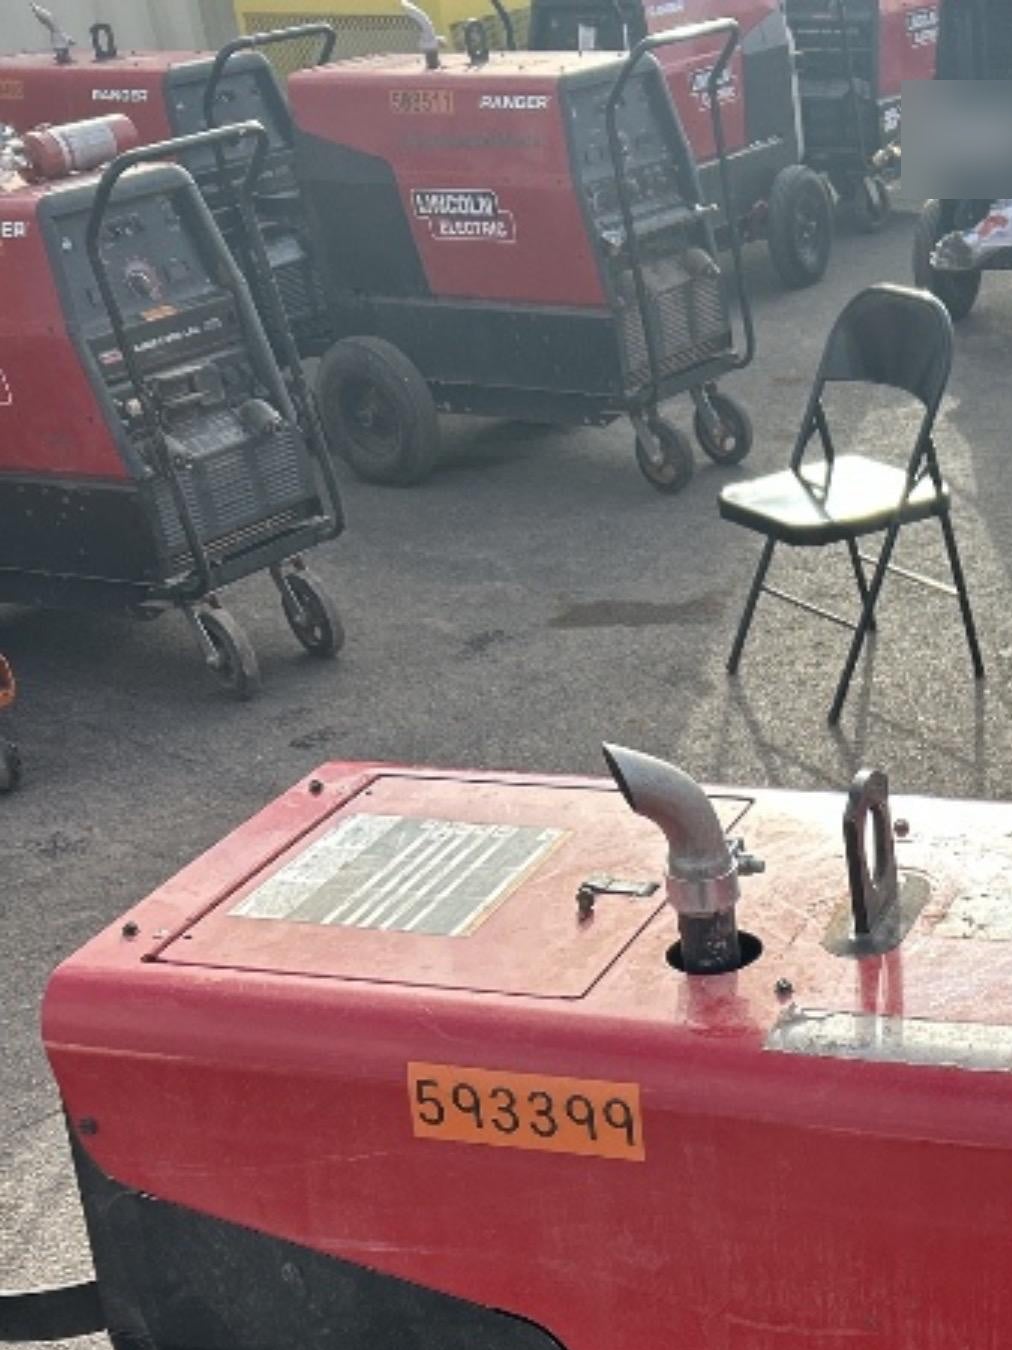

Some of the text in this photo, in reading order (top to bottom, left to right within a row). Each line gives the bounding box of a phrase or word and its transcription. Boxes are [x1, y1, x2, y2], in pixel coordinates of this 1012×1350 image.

[415, 194, 494, 216] LINCOLN
[439, 220, 508, 238] ELECTRIC
[415, 1078, 637, 1147] 593399
